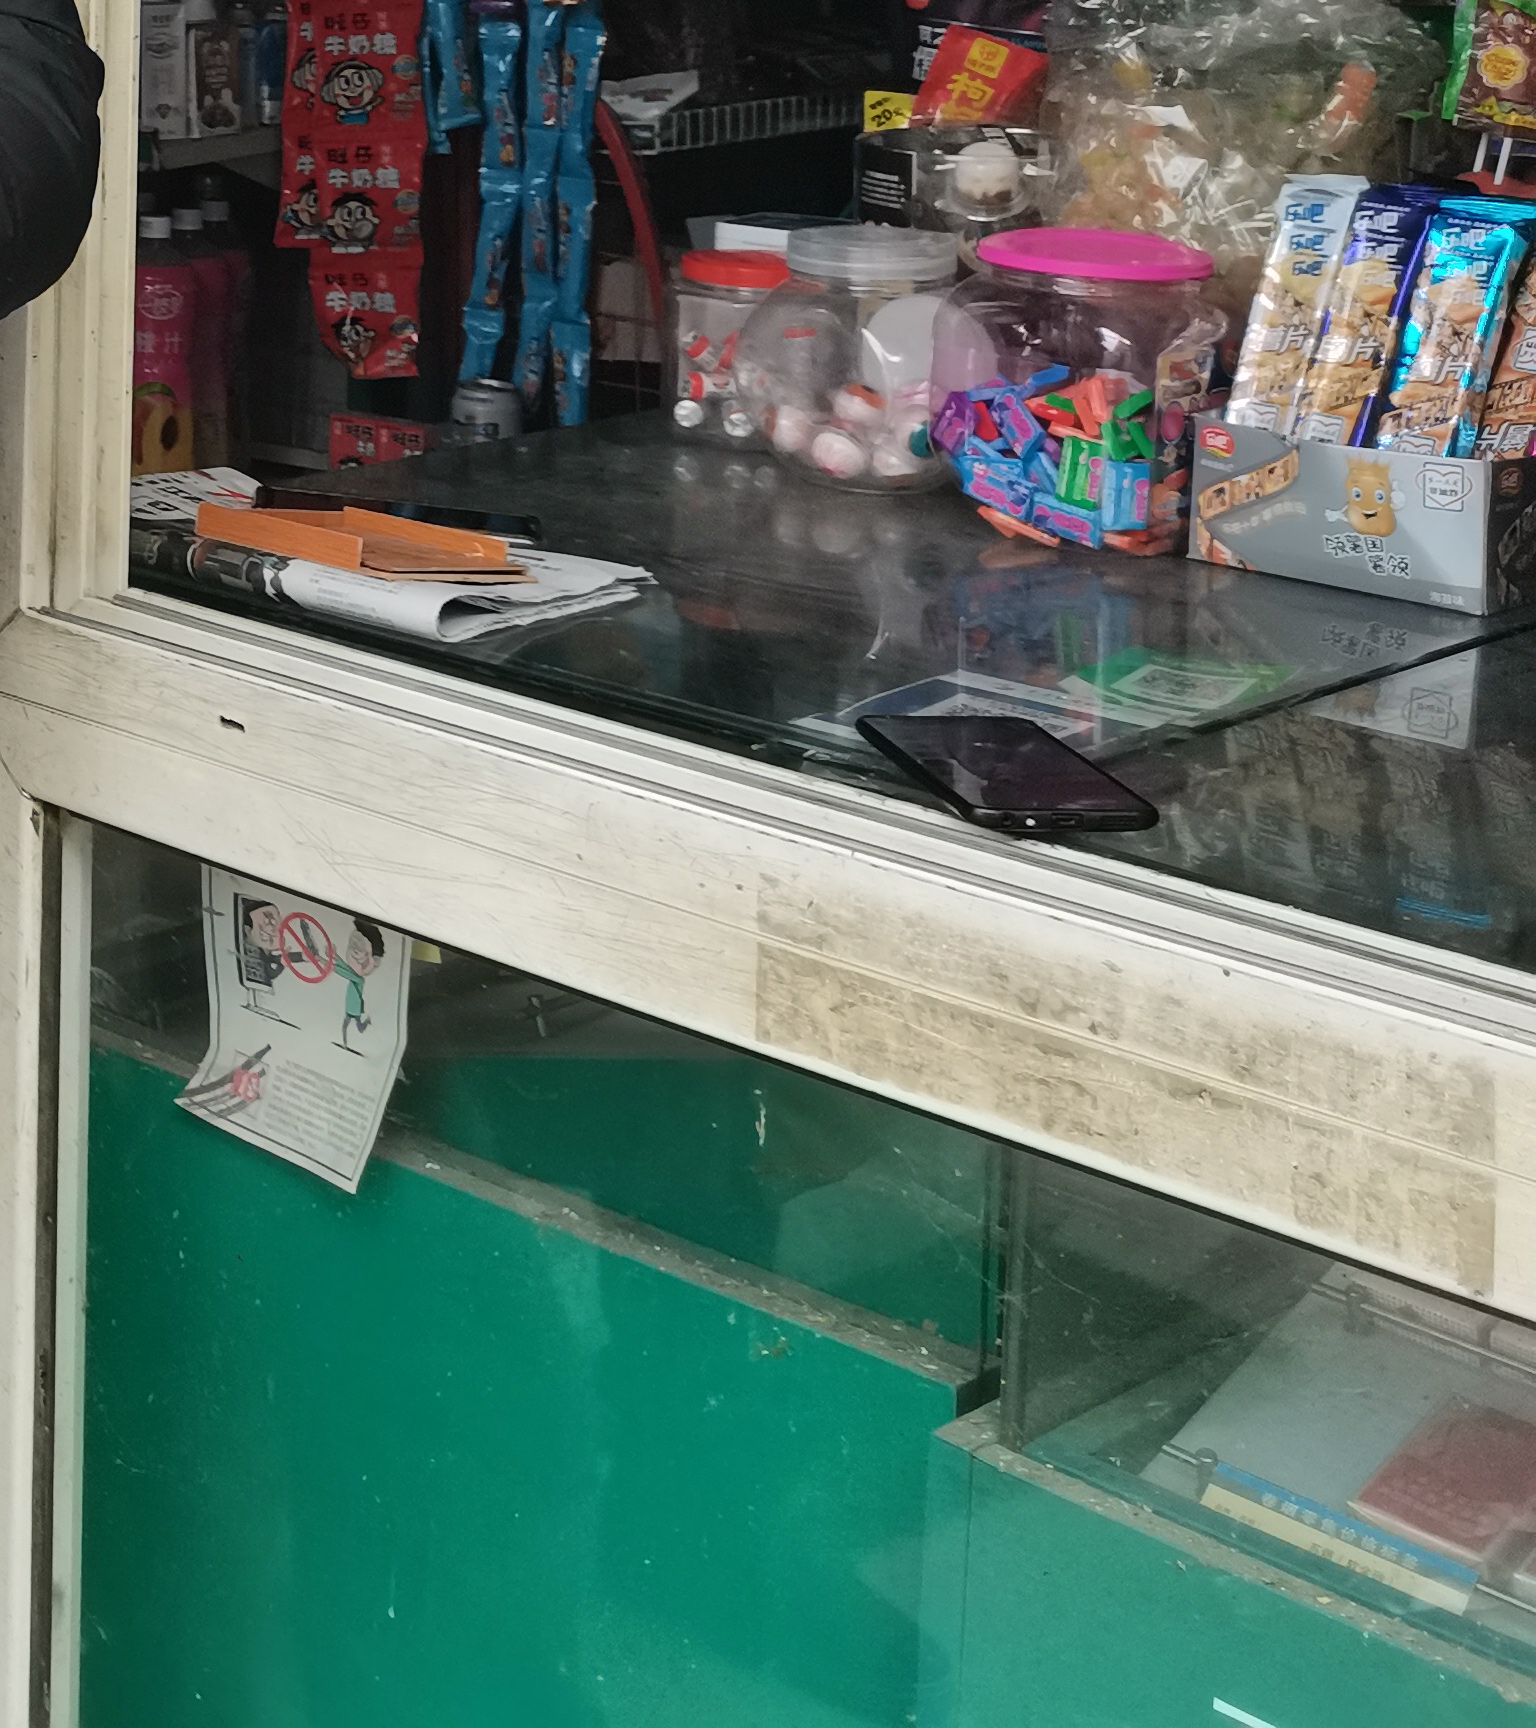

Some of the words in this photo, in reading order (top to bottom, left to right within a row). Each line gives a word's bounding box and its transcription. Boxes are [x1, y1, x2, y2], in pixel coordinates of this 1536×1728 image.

[323, 12, 373, 31] 旺仔
[323, 32, 399, 56] 牛奶糖
[325, 145, 375, 165] 旺仔
[325, 167, 400, 190] 牛奶糖
[324, 290, 398, 314] 牛奶糖
